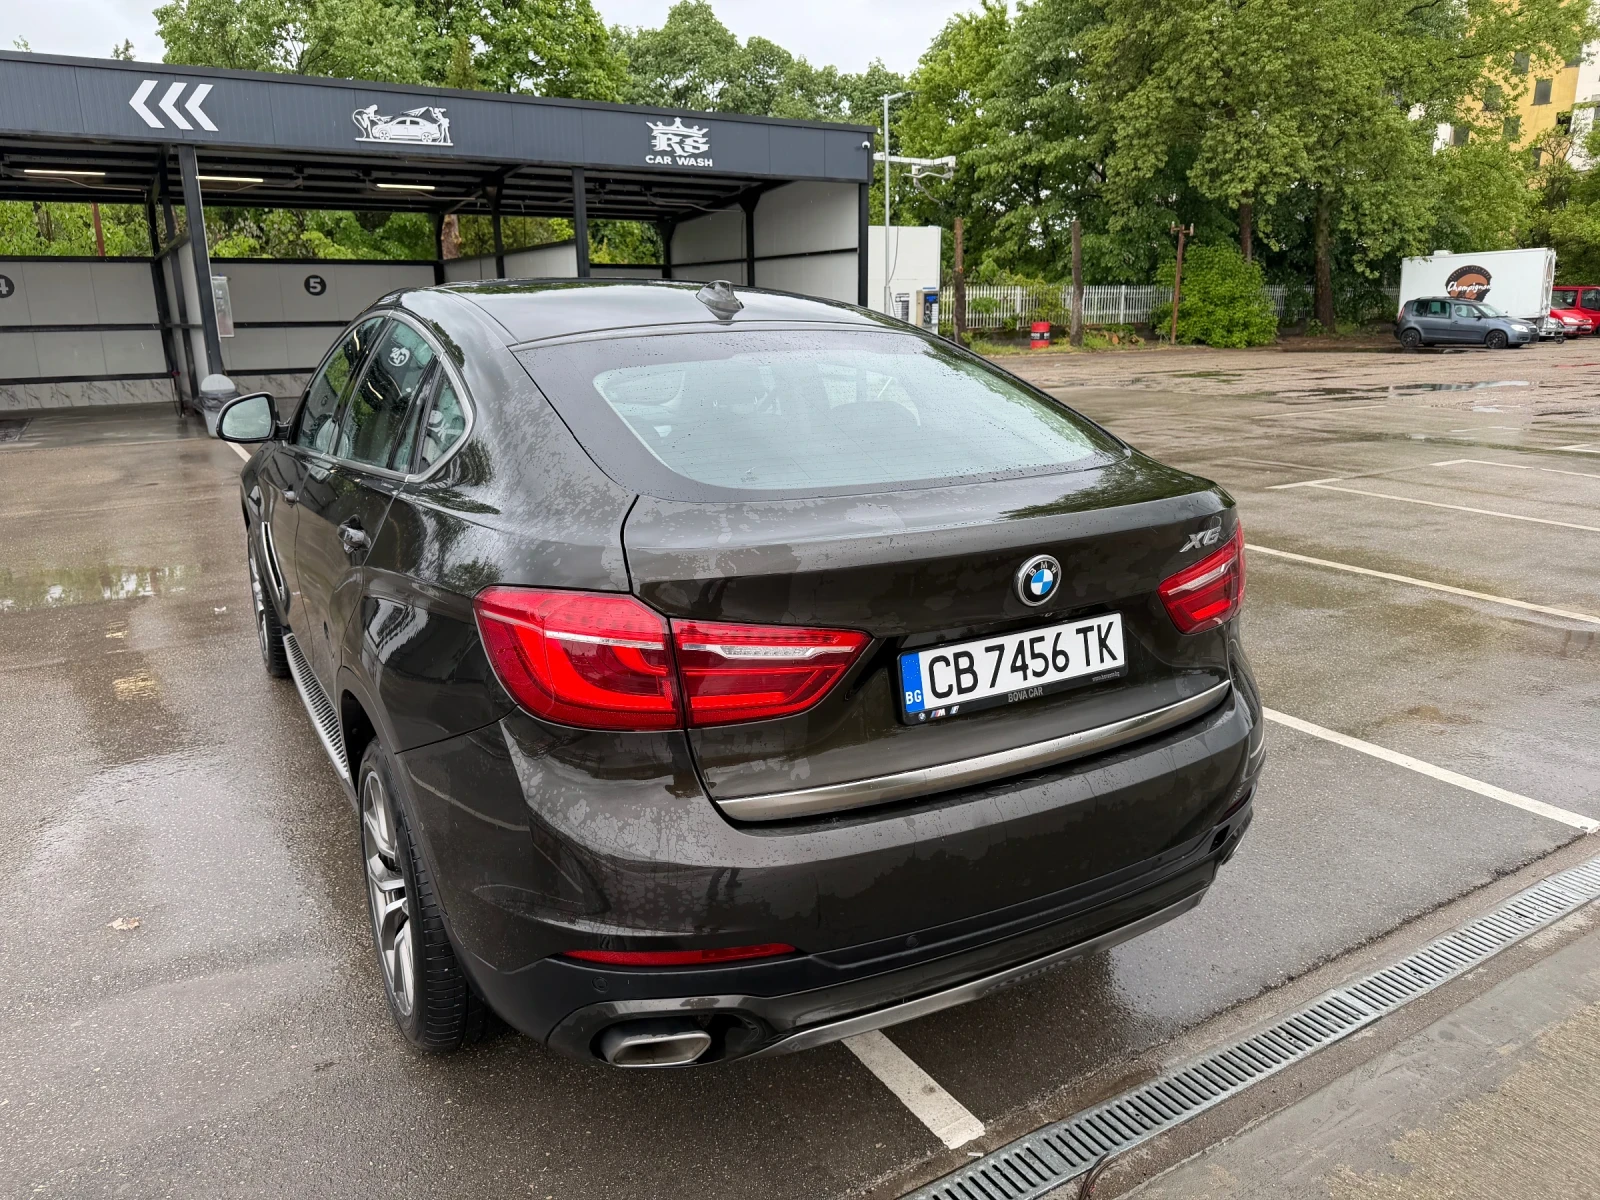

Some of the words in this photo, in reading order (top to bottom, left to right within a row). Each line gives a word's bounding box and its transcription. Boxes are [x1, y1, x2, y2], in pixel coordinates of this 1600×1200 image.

[645, 155, 672, 165] CAR
[676, 156, 713, 167] WASH
[308, 277, 322, 292] 5
[1179, 526, 1221, 553] X6
[1028, 560, 1059, 577] BMW
[905, 688, 922, 705] BG
[928, 650, 979, 699] CB
[984, 632, 1070, 689] 7456
[1075, 621, 1118, 667] TK
[1008, 689, 1027, 703] BOVA
[1028, 686, 1044, 699] CAR
